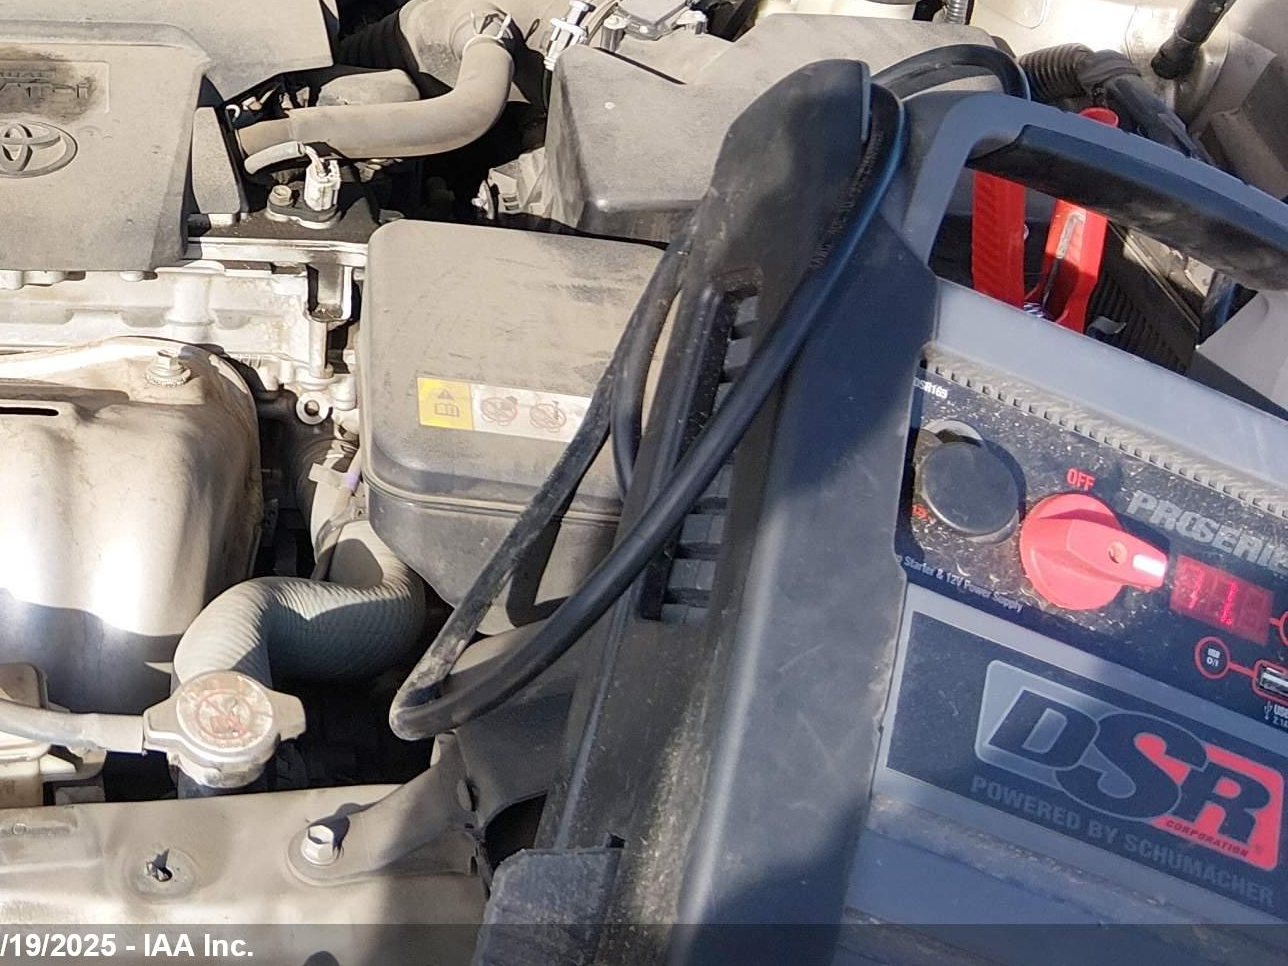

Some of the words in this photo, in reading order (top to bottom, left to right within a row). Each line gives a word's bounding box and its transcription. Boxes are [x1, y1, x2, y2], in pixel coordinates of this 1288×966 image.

[1066, 467, 1097, 490] OFF
[903, 555, 935, 576] Starter
[987, 687, 1273, 846] DSR
[969, 774, 1083, 832] POWERED
[1086, 819, 1121, 843] BY
[1122, 834, 1277, 908] SCHUMACHER
[1164, 818, 1250, 859] CORPORATION
